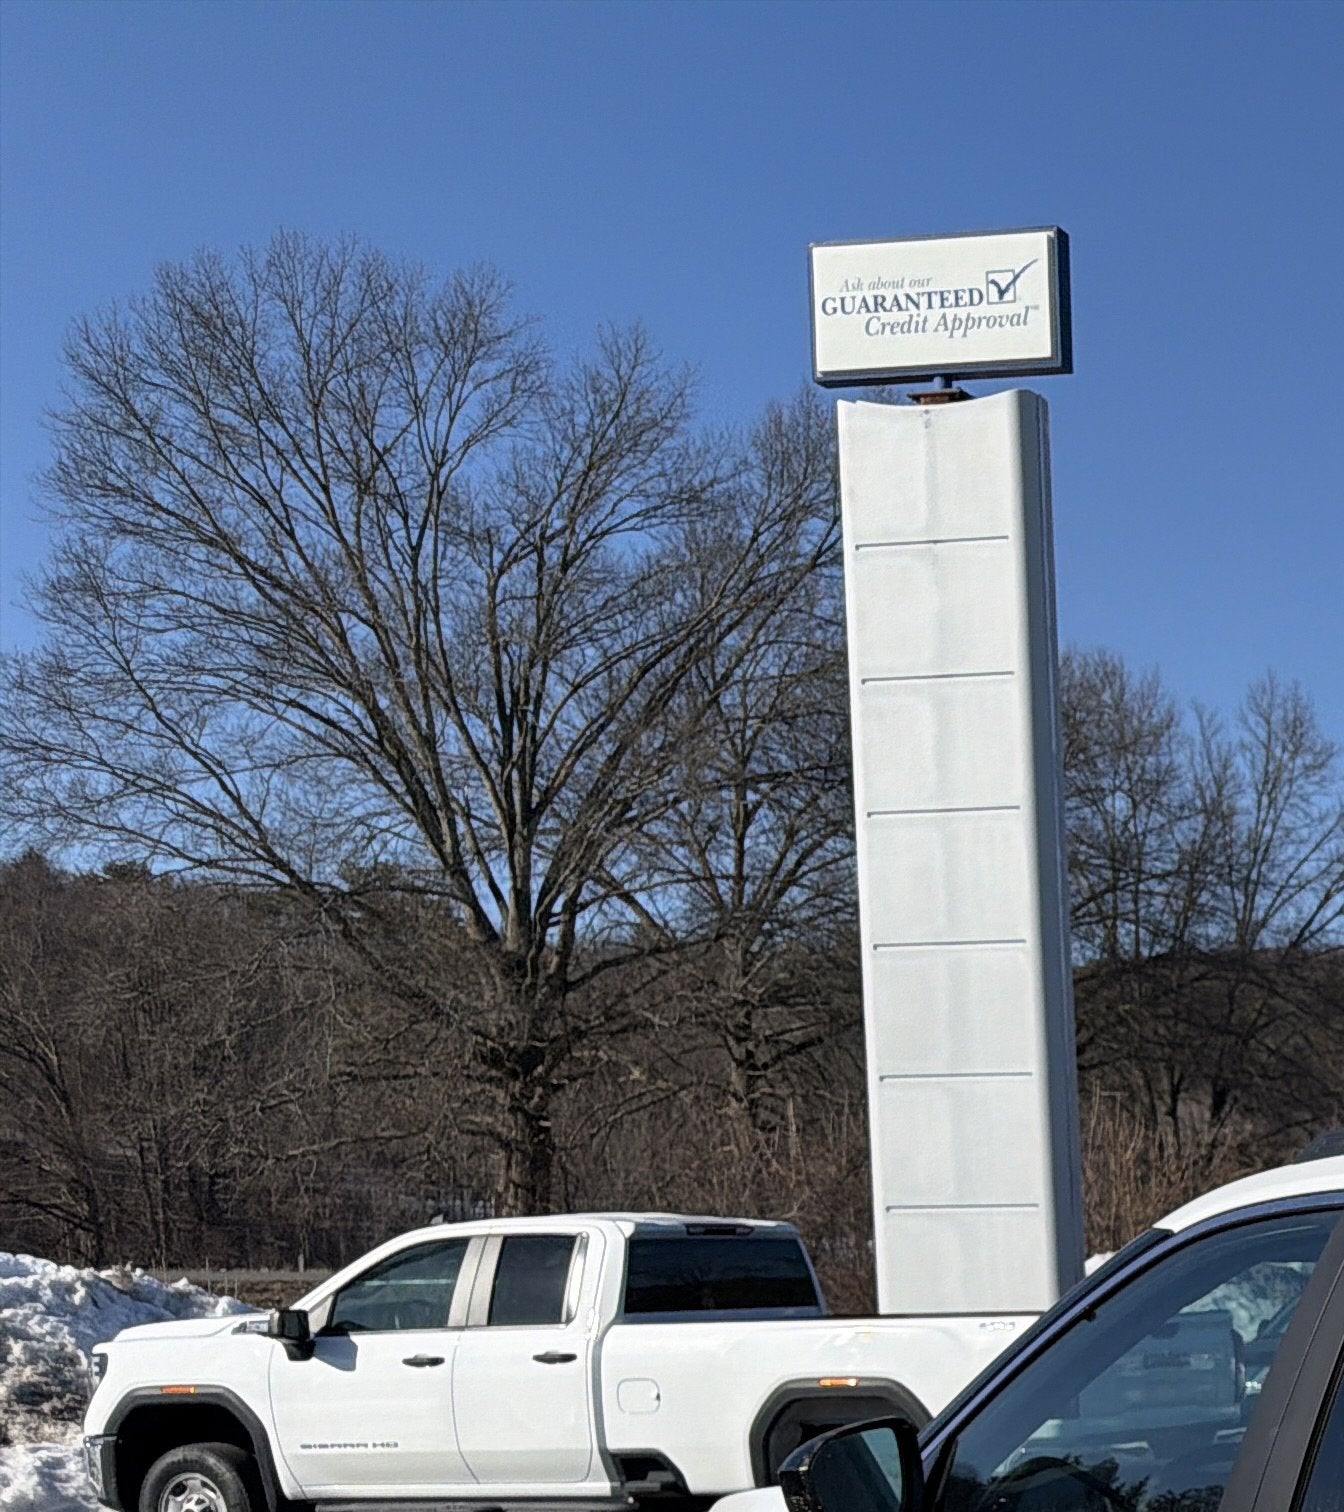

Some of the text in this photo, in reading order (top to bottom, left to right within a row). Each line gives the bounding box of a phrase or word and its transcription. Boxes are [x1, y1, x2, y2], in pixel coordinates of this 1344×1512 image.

[840, 275, 933, 292] Ask about our
[821, 287, 984, 316] GUARANTEED
[865, 305, 1030, 339] Credit Approval
